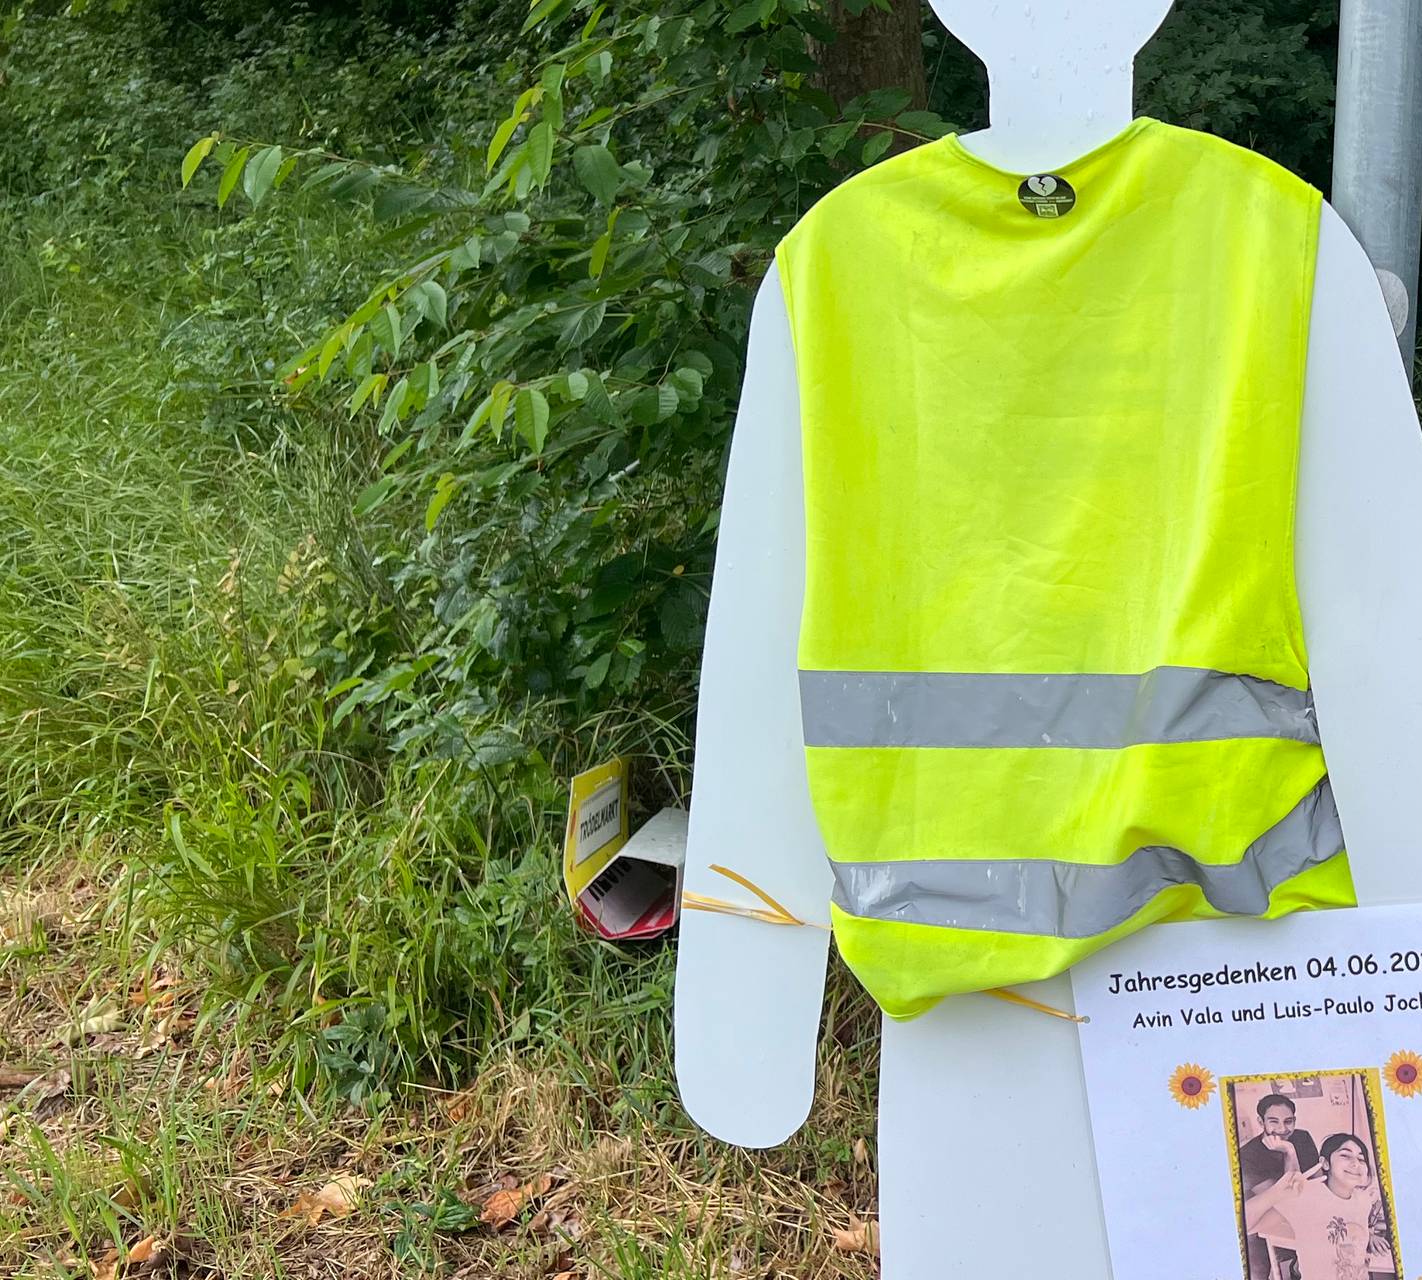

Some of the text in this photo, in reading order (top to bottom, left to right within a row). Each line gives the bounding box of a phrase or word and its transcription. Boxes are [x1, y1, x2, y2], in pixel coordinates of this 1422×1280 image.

[580, 798, 619, 843] TRÖDELMARKT
[1108, 961, 1297, 994] Jahresgedenken
[1132, 1011, 1173, 1029] Avin
[1180, 1006, 1223, 1026] Vala
[1231, 1002, 1265, 1022] und
[1273, 994, 1374, 1020] Luis-Paulo
